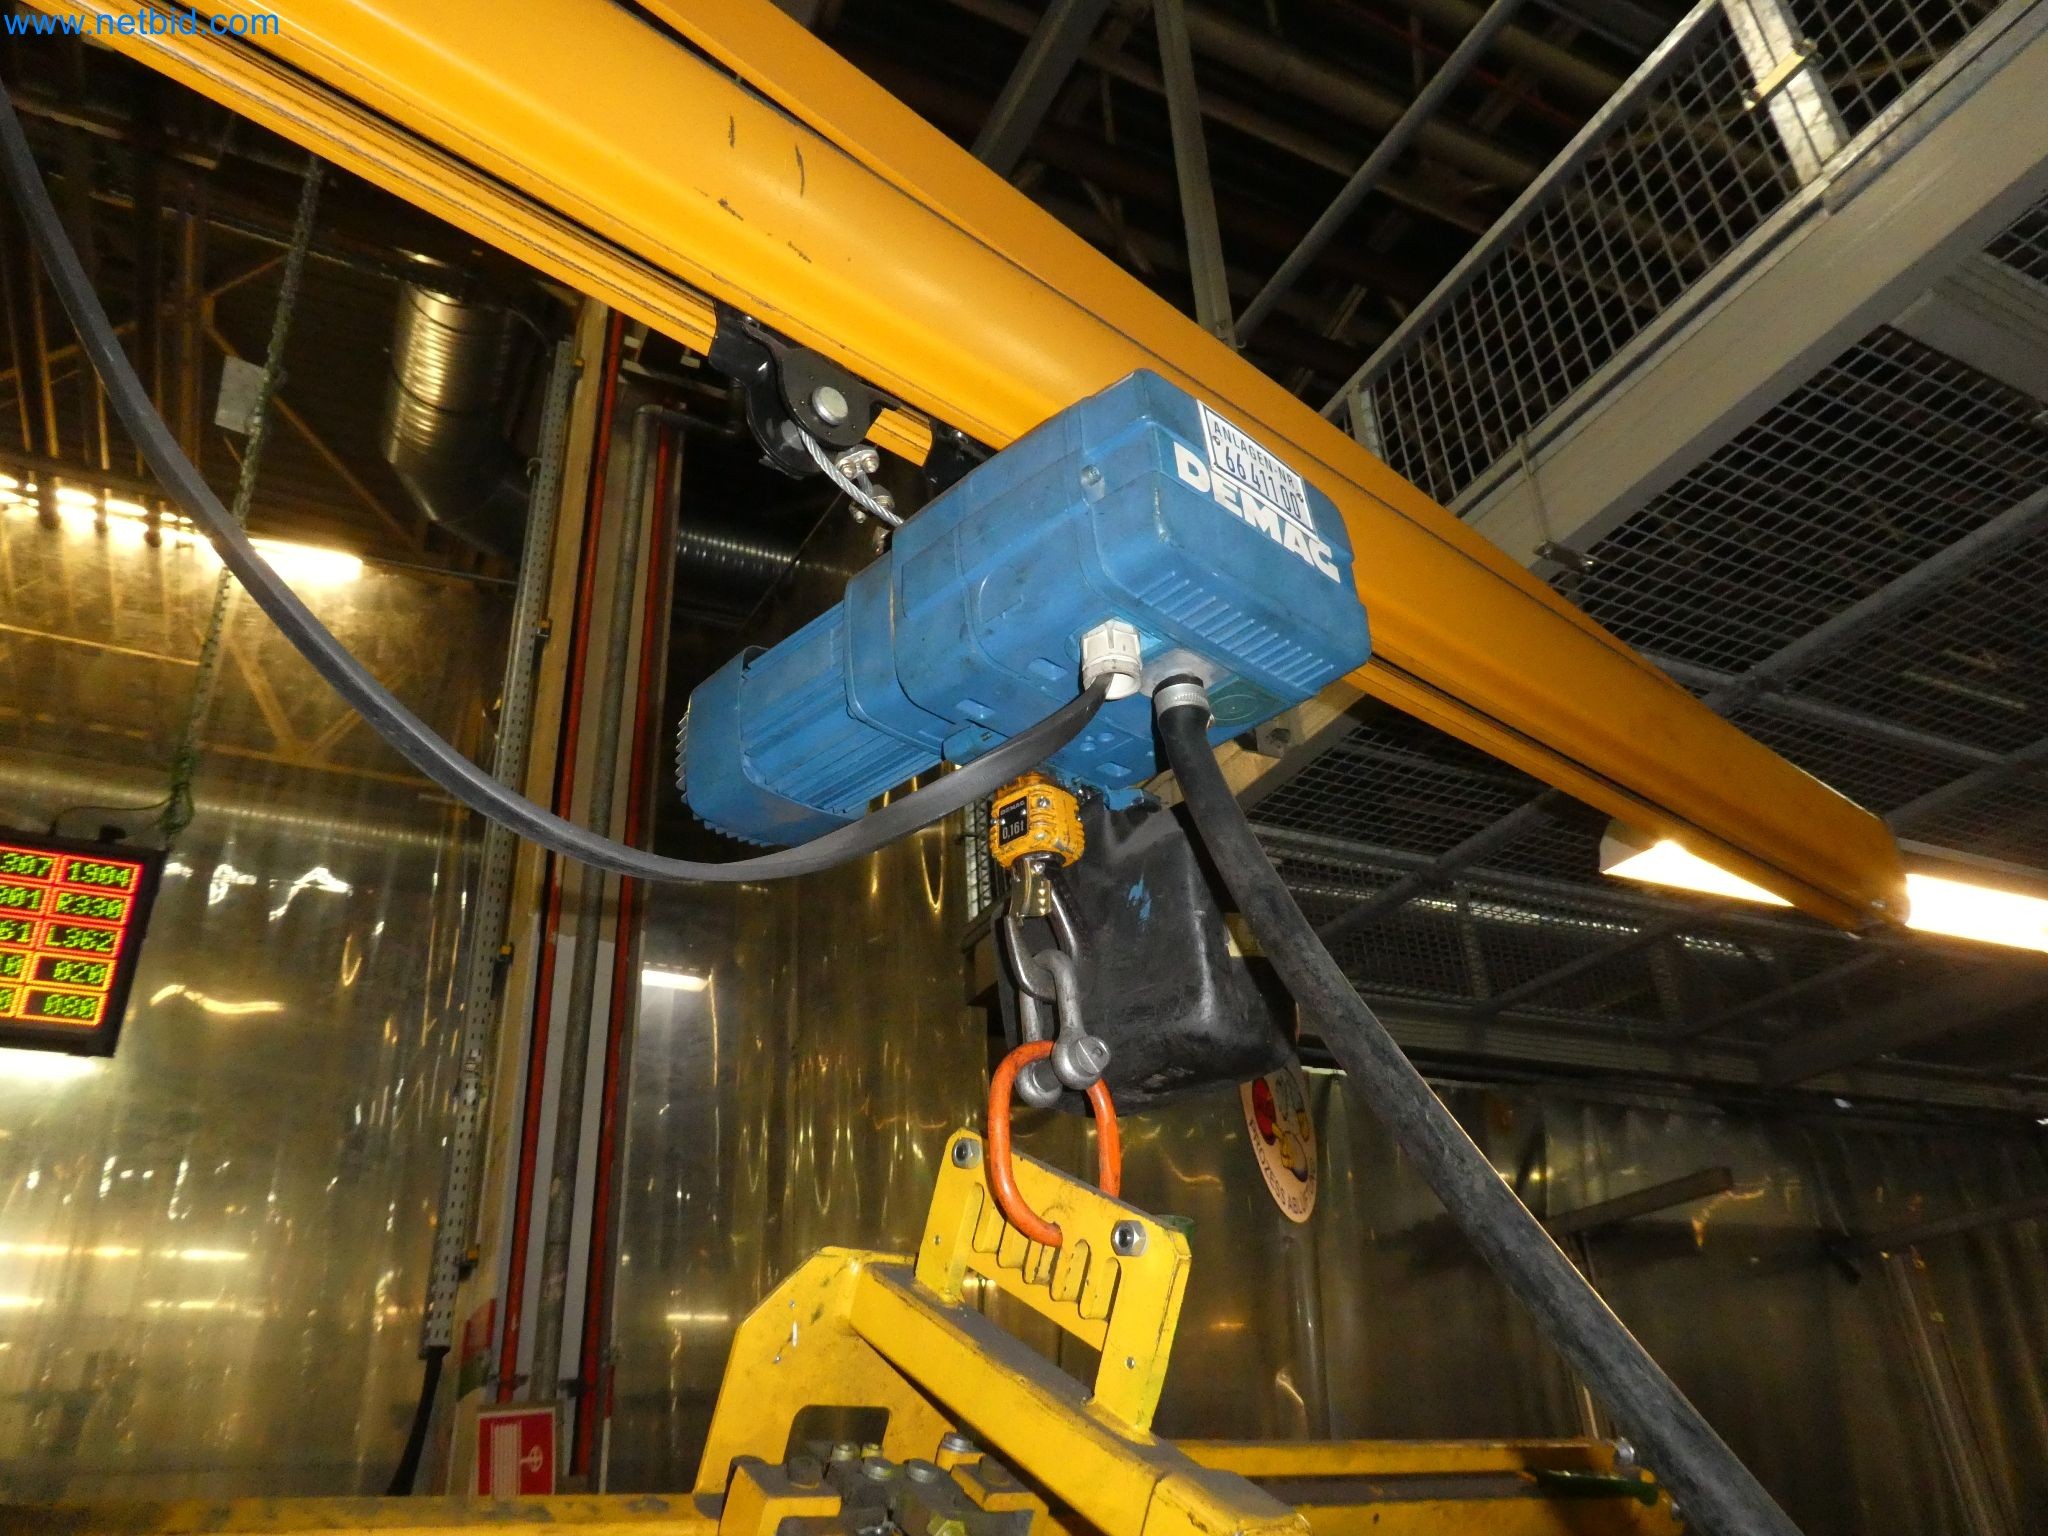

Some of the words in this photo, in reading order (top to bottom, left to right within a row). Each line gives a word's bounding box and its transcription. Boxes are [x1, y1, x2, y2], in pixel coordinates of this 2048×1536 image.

[1225, 446, 1247, 480] 66
[1173, 441, 1341, 584] DEMAG
[1000, 800, 1025, 816] DEMAG
